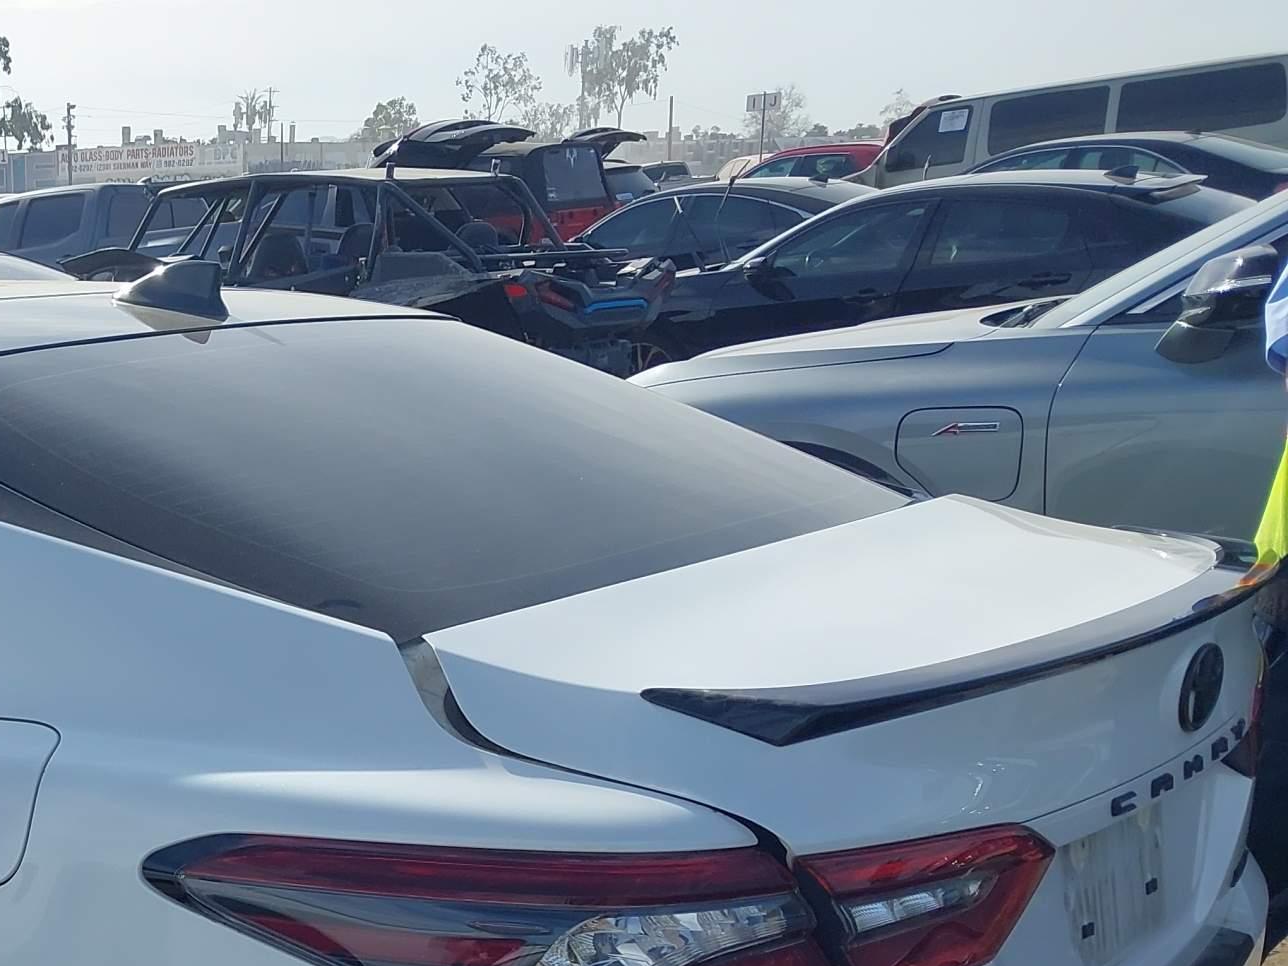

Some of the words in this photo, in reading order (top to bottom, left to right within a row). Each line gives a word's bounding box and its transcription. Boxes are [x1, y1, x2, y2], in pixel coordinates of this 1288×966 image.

[769, 95, 777, 107] J
[61, 151, 79, 163] AUO
[1110, 718, 1246, 817] CAMRY
